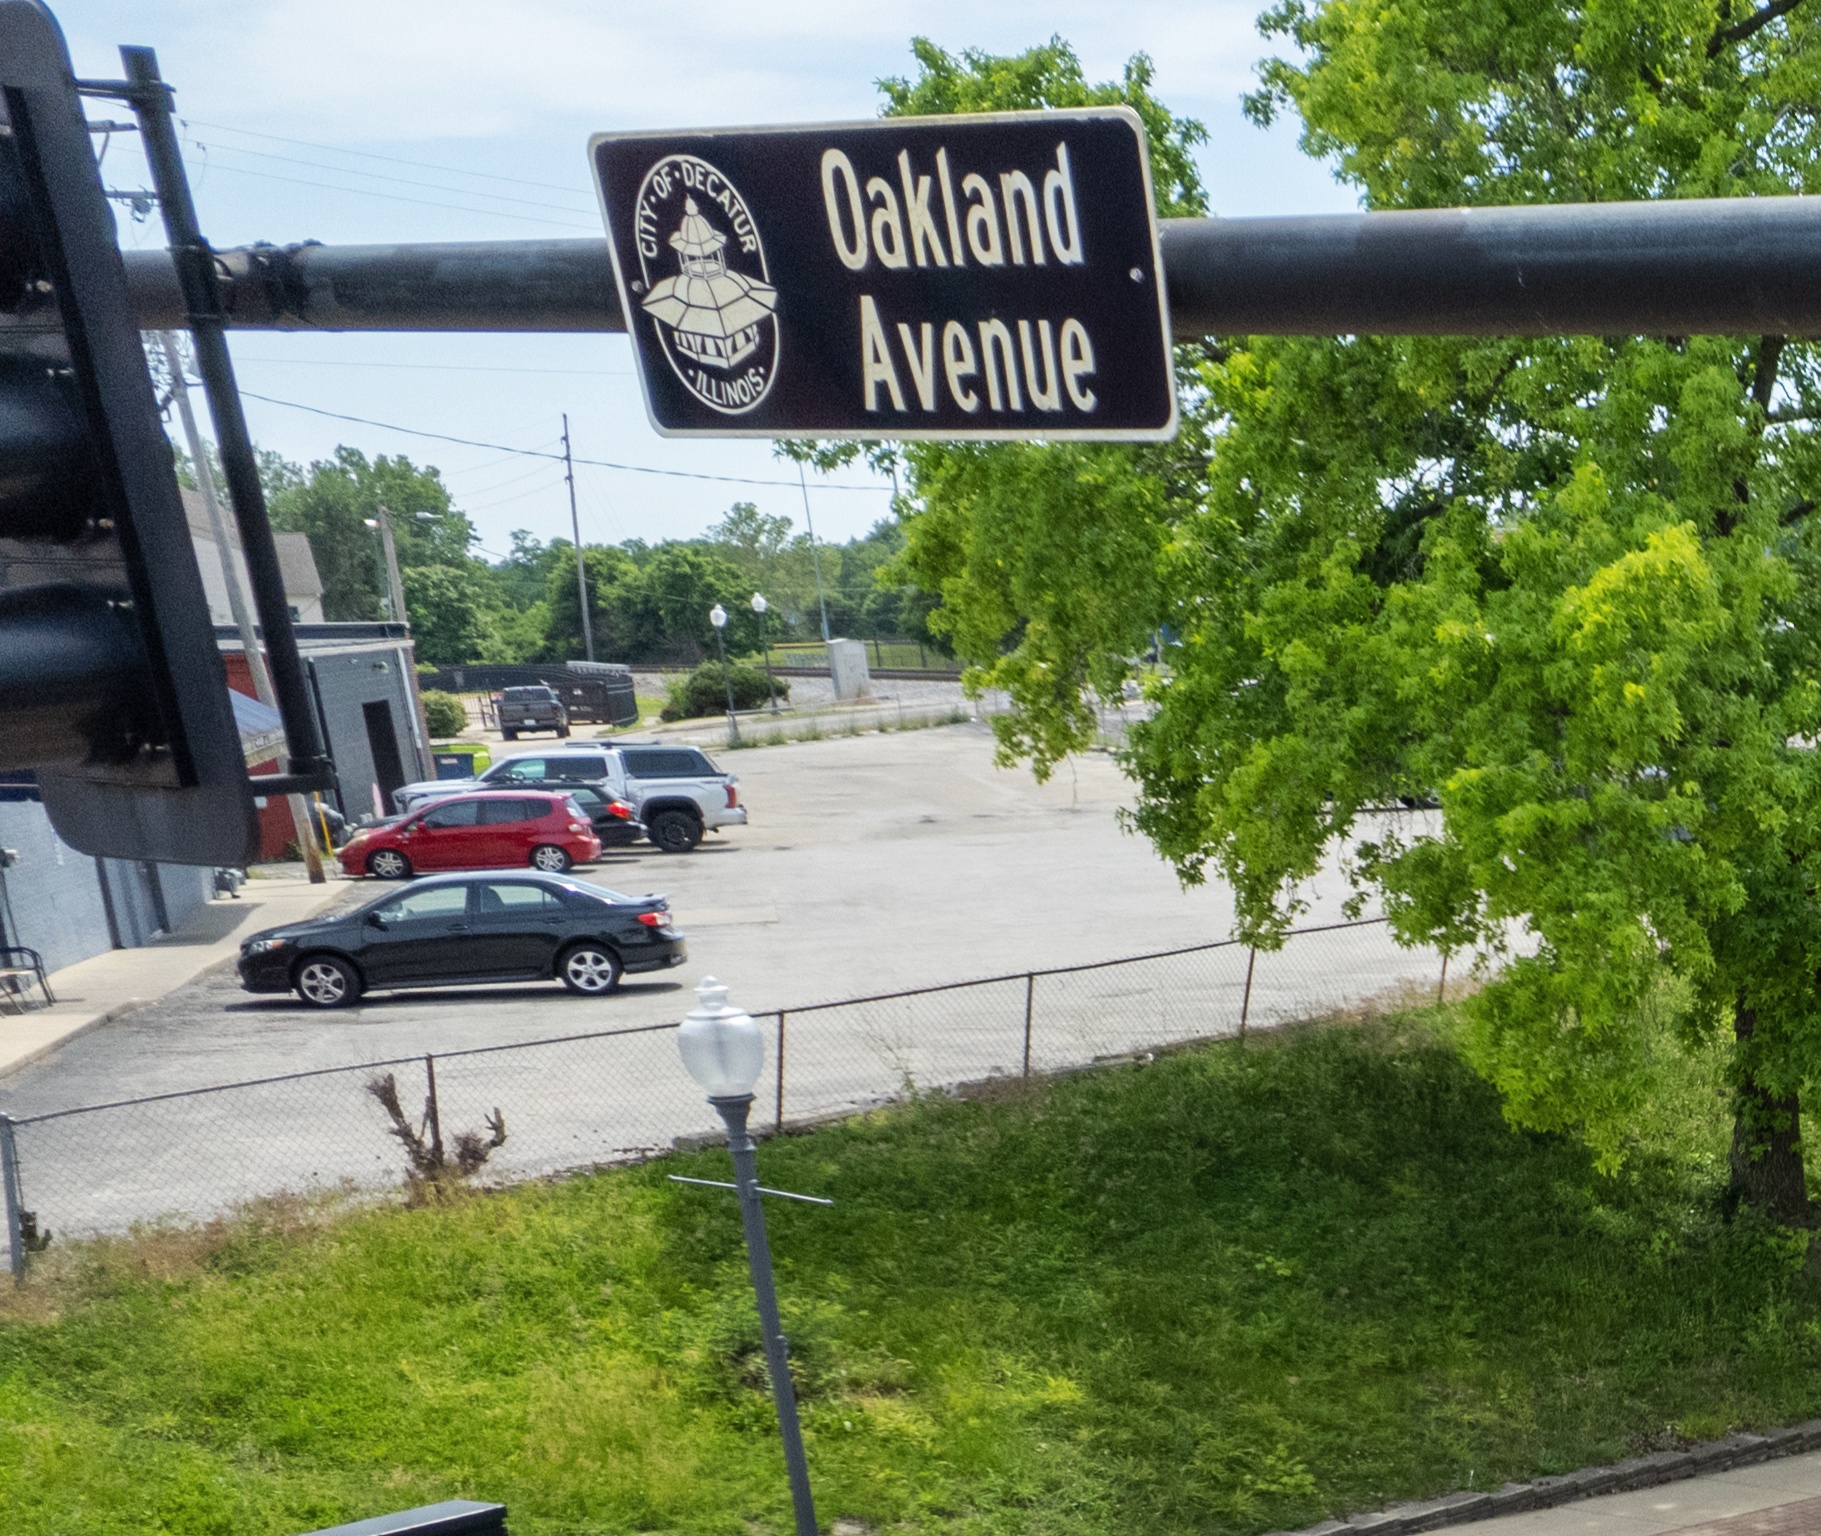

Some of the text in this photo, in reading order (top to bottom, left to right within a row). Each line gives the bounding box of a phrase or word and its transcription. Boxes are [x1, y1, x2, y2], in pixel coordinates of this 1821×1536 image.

[640, 161, 757, 258] CITY OF DECATUR
[821, 142, 1084, 270] Oakland
[696, 368, 764, 406] ILLINOIS
[860, 295, 1098, 413] Avenue
